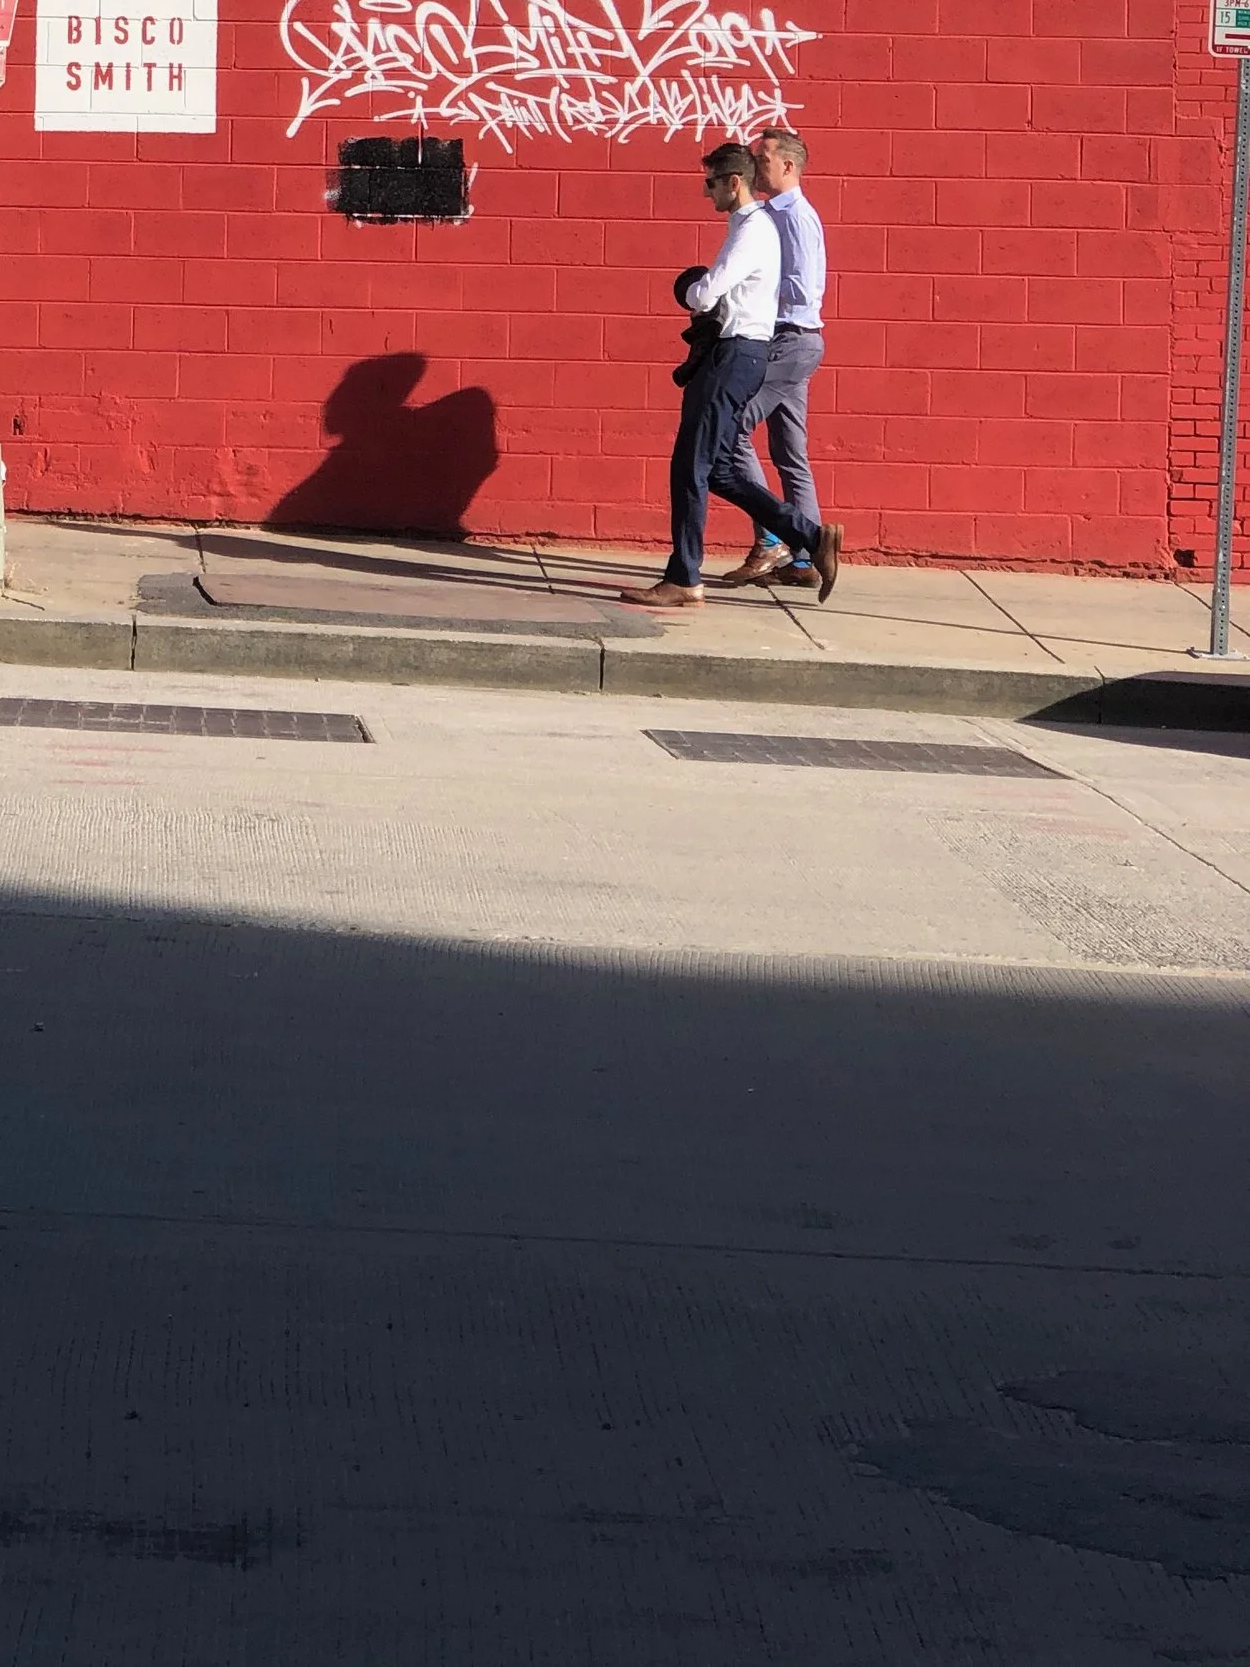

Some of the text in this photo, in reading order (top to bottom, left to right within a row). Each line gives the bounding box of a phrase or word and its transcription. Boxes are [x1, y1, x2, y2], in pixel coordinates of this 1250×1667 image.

[67, 15, 184, 45] BISCO
[1220, 11, 1231, 24] 15
[66, 62, 184, 92] SMITH
